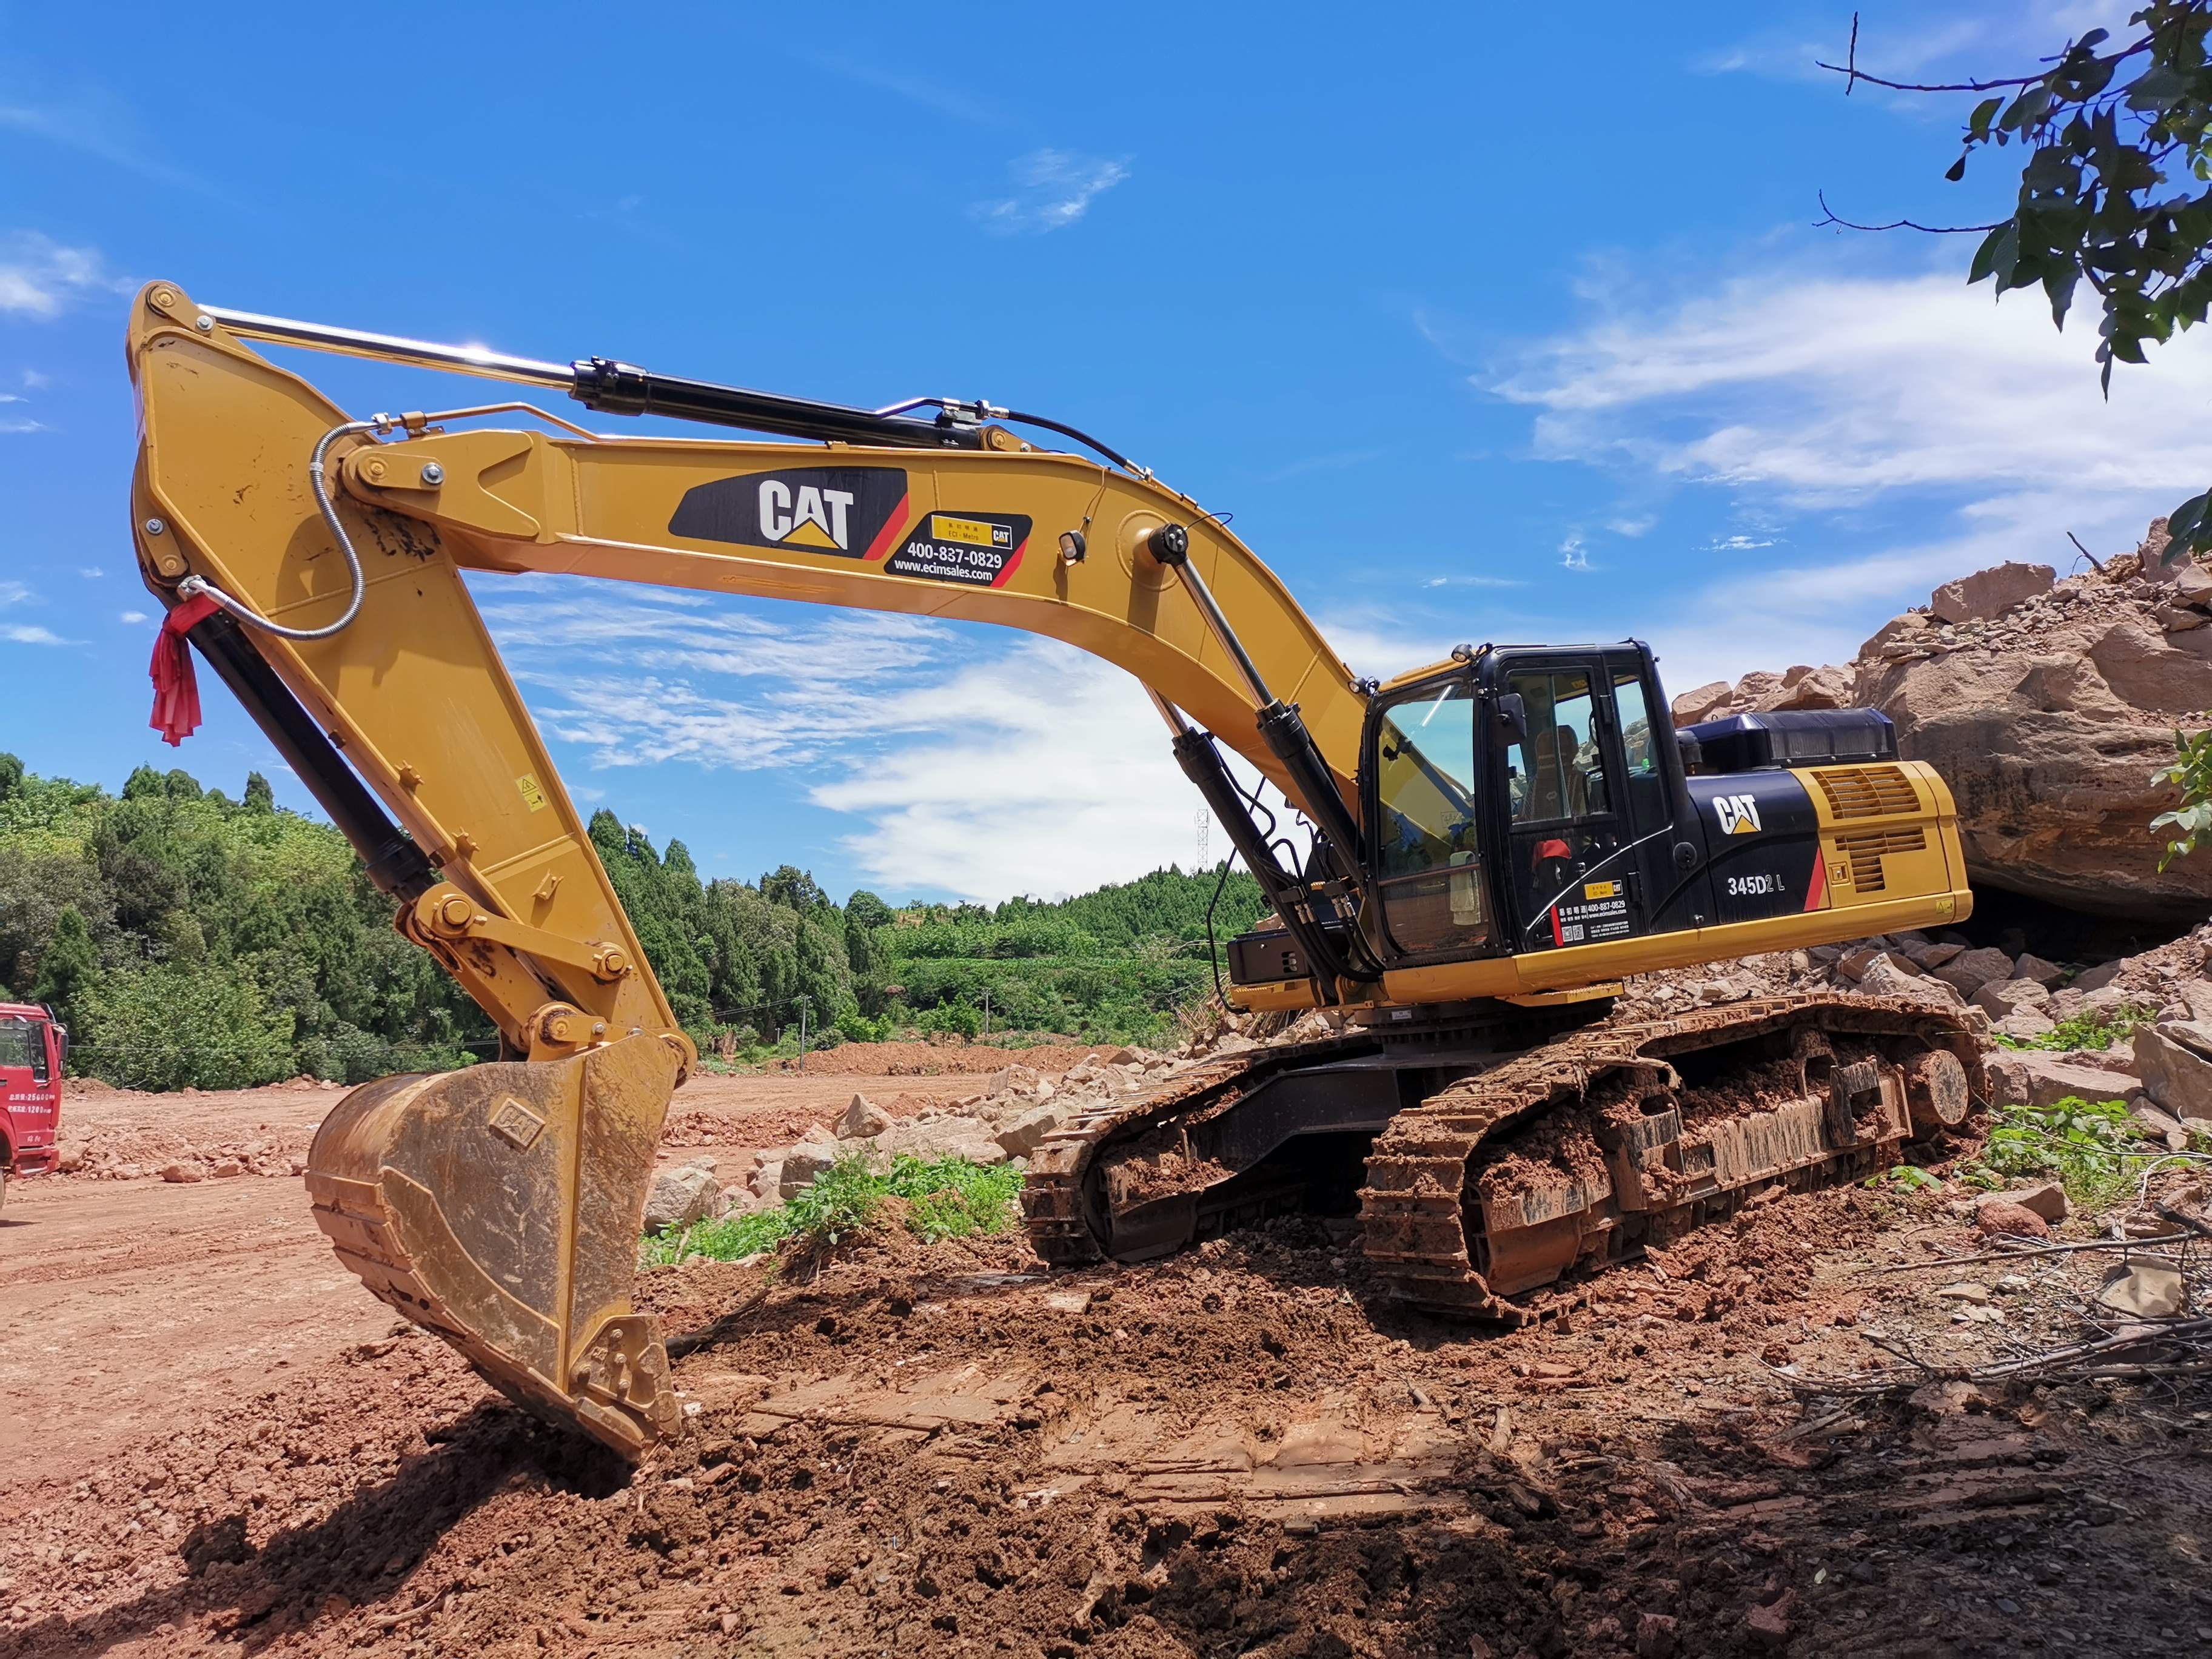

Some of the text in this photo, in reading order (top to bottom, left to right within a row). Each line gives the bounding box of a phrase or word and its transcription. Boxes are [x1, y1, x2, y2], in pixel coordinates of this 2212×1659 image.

[759, 480, 854, 550] CAT
[992, 529, 1010, 543] CAT
[894, 560, 993, 581] www.ecimsales.com
[1712, 794, 1761, 834] CAT
[497, 1105, 541, 1141] CAT
